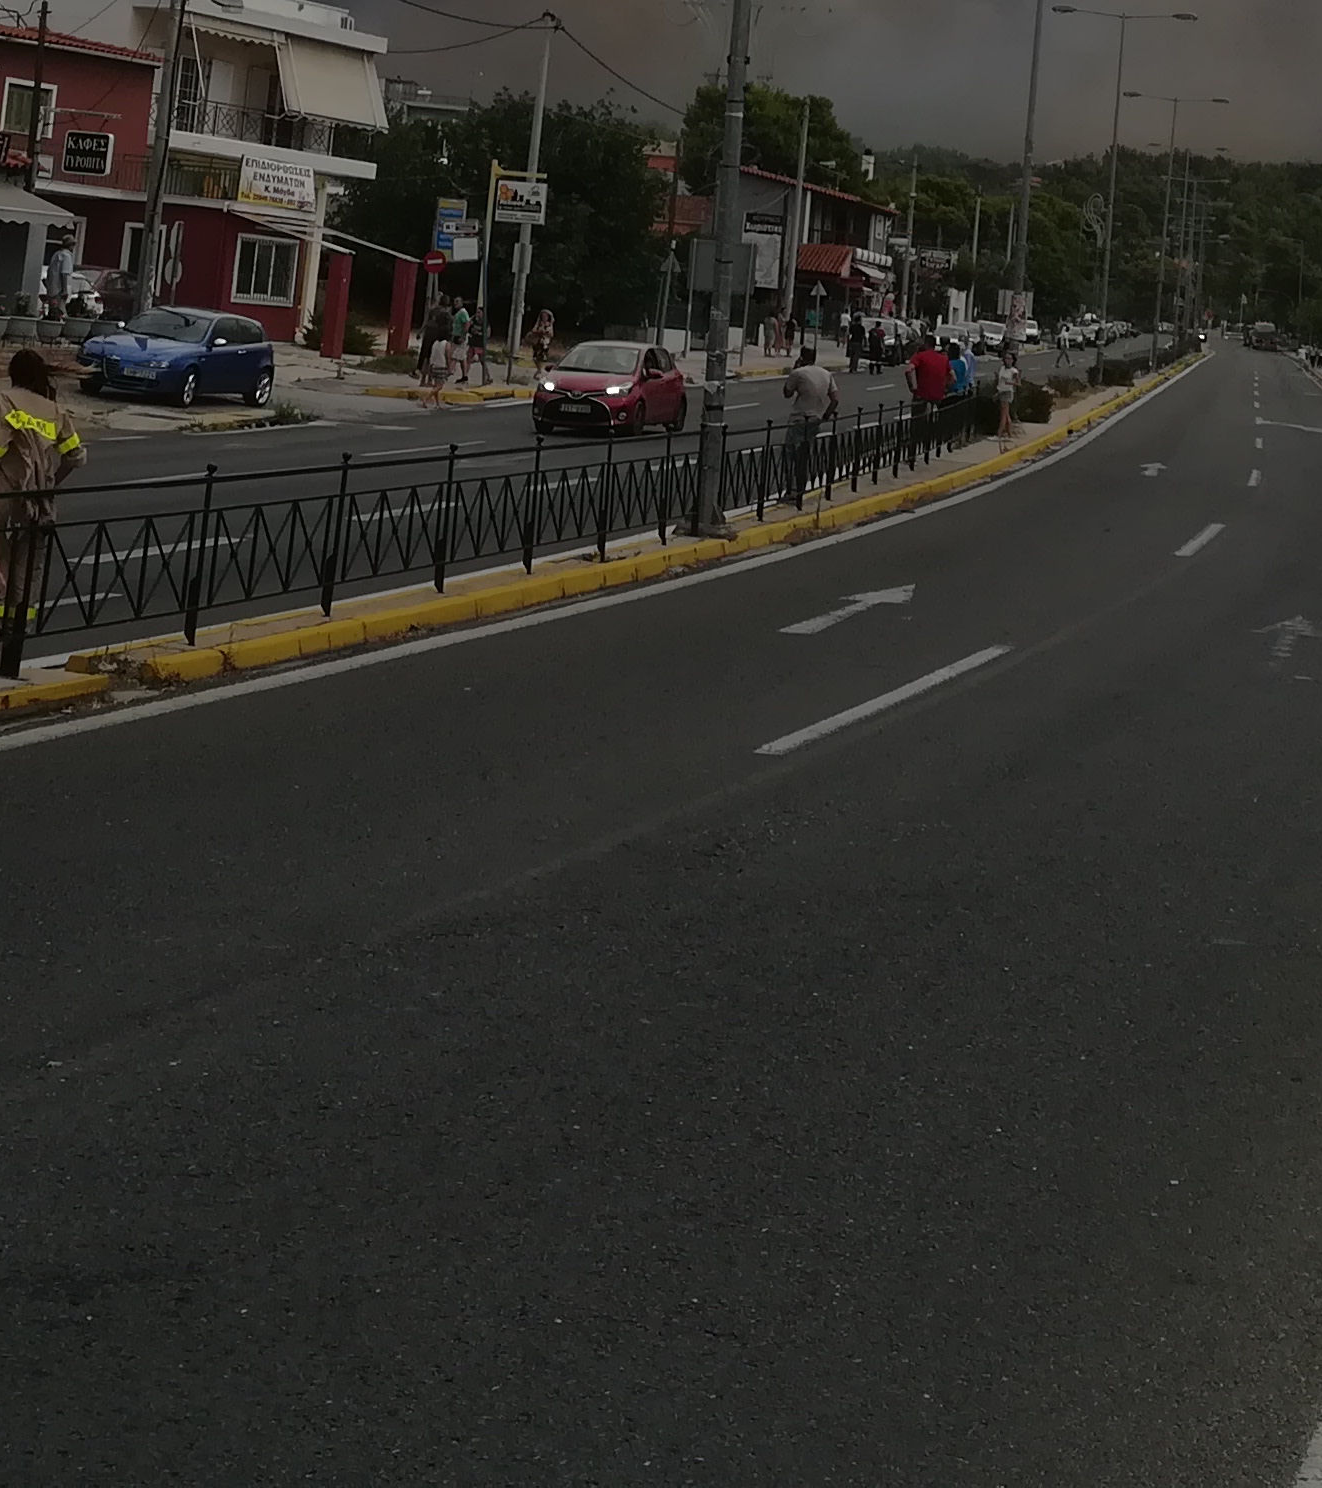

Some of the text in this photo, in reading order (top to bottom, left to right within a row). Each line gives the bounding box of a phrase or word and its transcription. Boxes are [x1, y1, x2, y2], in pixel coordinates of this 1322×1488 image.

[68, 136, 107, 151] ΚΑΦΕΣ
[245, 158, 312, 178] ΕΠΙΔΙΟΡΘΩΣΕΙΣ
[253, 172, 305, 188] ΕΝΔΥΜΑΤΩΝ
